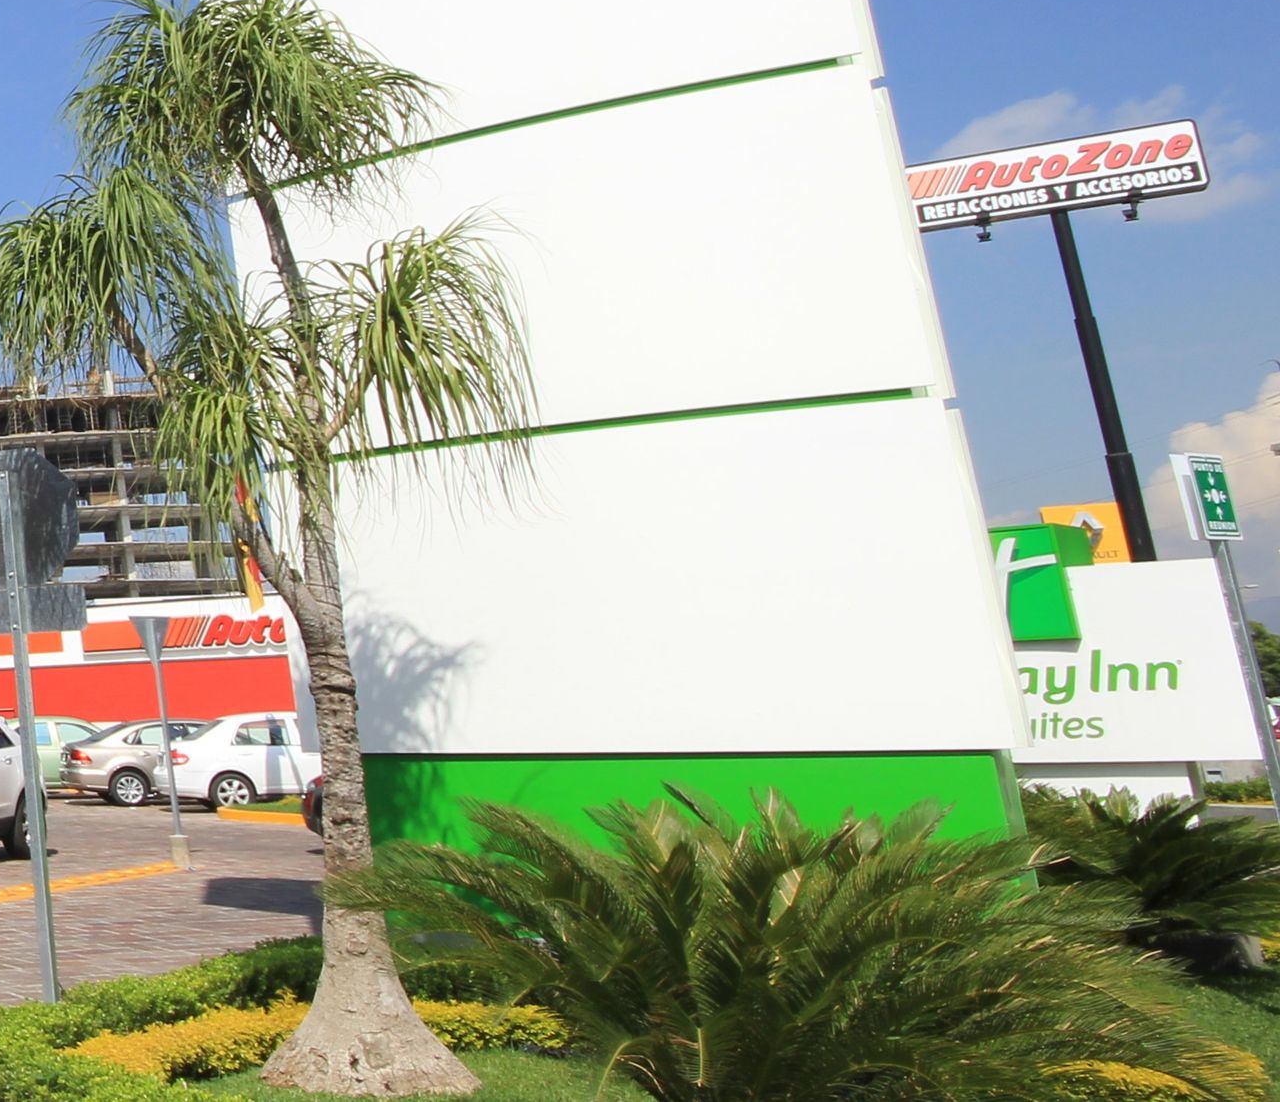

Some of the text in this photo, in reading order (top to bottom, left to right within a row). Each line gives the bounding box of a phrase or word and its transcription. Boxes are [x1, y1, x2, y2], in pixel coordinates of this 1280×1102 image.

[958, 133, 1194, 192] AutoZone
[923, 165, 1194, 221] REFACCIONES Y ACCESORIOS
